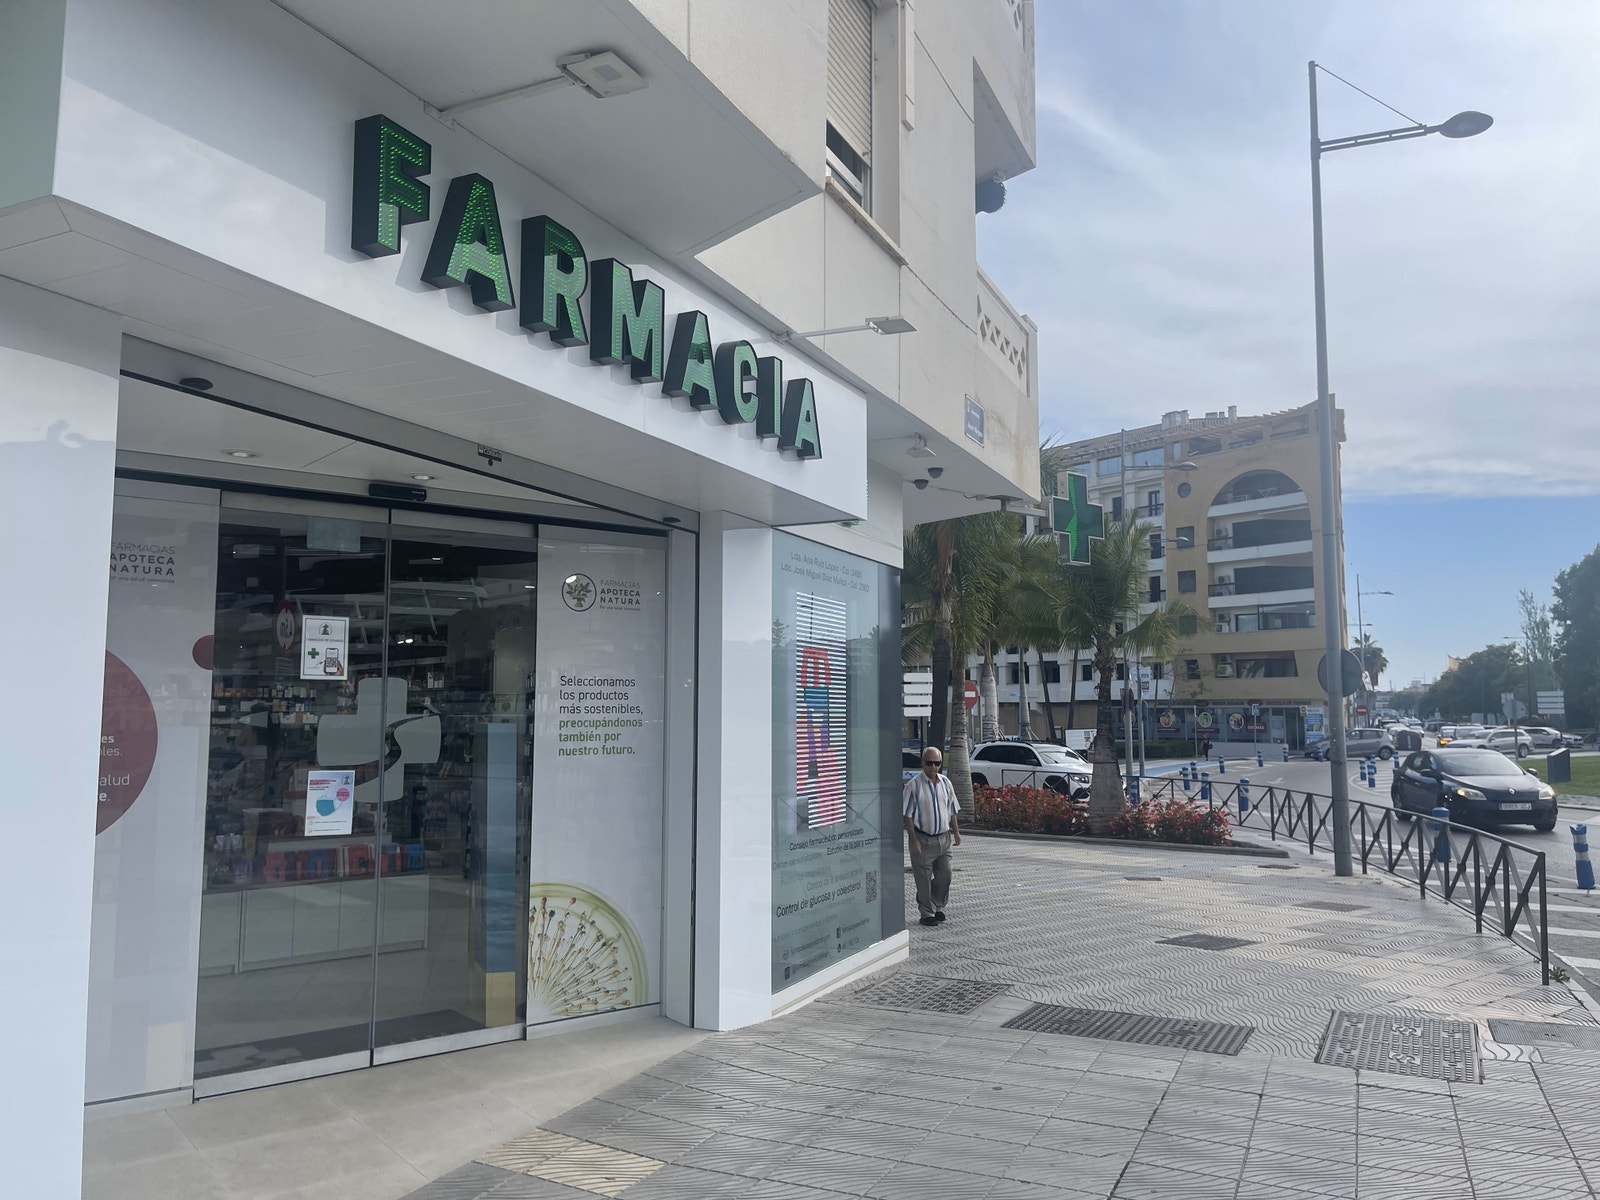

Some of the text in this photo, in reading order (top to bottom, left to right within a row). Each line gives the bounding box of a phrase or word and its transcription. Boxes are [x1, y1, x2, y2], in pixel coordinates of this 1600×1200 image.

[351, 114, 822, 459] FARMACIA
[111, 541, 176, 555] FARMACIAS
[110, 552, 175, 565] APOTECA
[804, 554, 813, 565] Ana
[814, 558, 824, 568] Ruiz
[110, 563, 175, 576] NATURA
[806, 568, 821, 580] Miguel
[600, 579, 640, 588] FARMACIAS
[600, 588, 640, 598] APOTECA
[600, 596, 640, 606] NATURA
[560, 676, 636, 687] Seleccionamos
[559, 690, 629, 702] los productos
[559, 703, 644, 716] más sostenibles,
[558, 716, 643, 730] preocupándonos
[558, 730, 622, 744] también por
[558, 745, 636, 756] nuestro futuro.
[790, 839, 808, 852] Consejo
[838, 828, 864, 840] personalizado
[843, 844, 849, 852] de
[776, 900, 799, 918] Control
[800, 898, 808, 910] de
[810, 892, 831, 909] glucosa
[831, 890, 836, 901] y
[836, 881, 861, 898] colesterol
